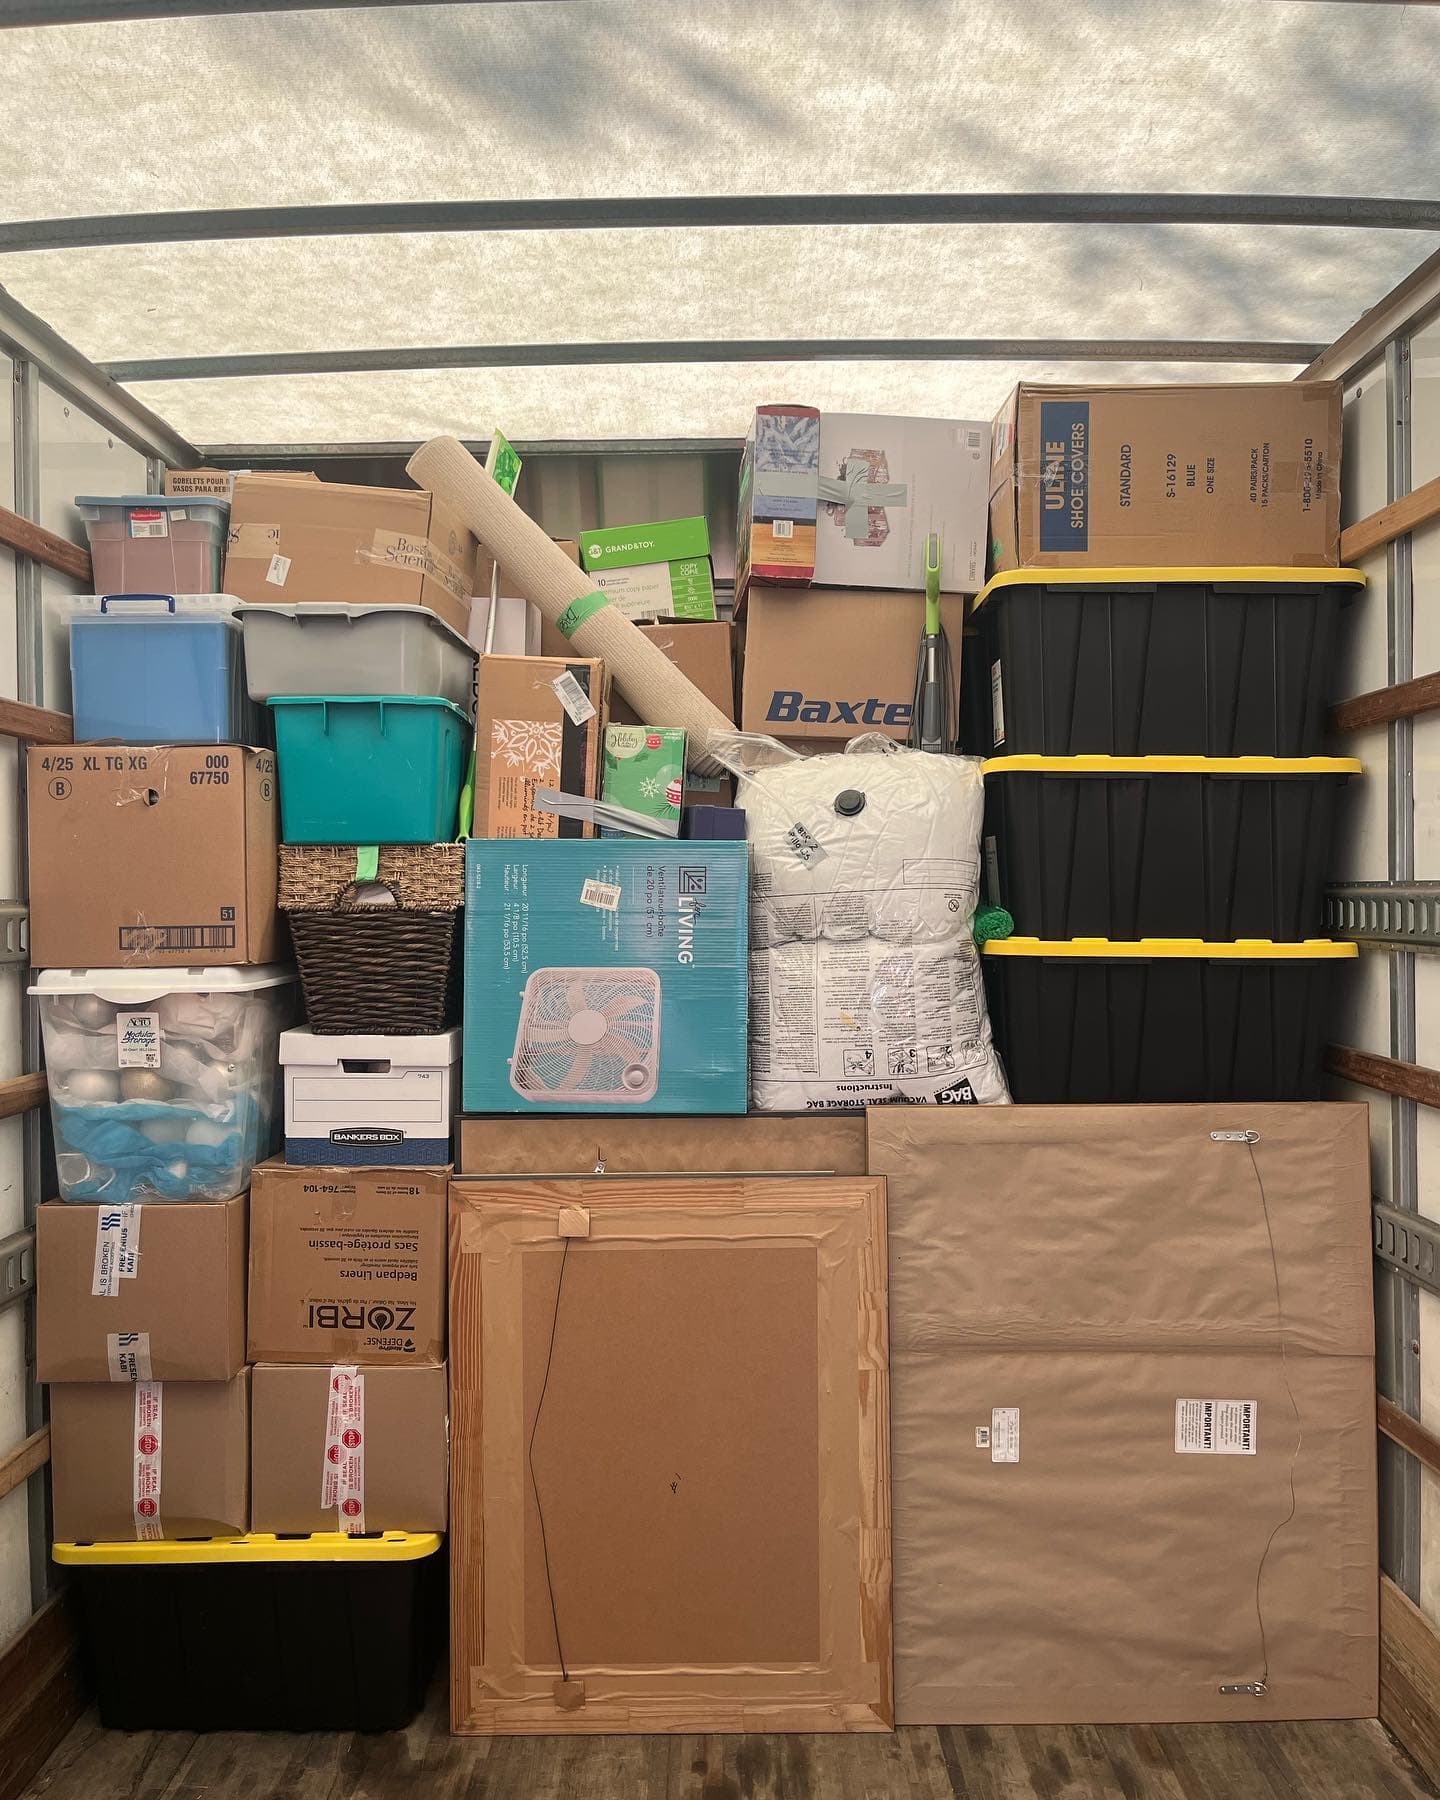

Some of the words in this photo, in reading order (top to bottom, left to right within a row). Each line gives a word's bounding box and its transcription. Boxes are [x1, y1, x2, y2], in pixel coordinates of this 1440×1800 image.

[1071, 422, 1085, 484] COVERS
[1207, 457, 1215, 474] SIZE
[172, 477, 204, 485] GOBELETS
[1120, 444, 1132, 507] STANDARD
[1166, 453, 1177, 498] S-16129
[1186, 464, 1196, 487] BLUE
[1070, 490, 1084, 529] SHOE
[606, 541, 654, 554] GRAND&TOY
[598, 578, 606, 586] 10
[765, 690, 914, 726] Baxte
[42, 757, 73, 771] 4/25
[82, 757, 100, 770] XL
[105, 756, 123, 770] TG
[128, 756, 148, 770] XG
[206, 755, 229, 769] 000
[190, 771, 230, 785] 67750
[56, 782, 64, 796] B
[512, 864, 520, 890] Largeur
[646, 866, 655, 877] de
[646, 880, 655, 890] 20
[644, 892, 652, 904] po
[658, 866, 666, 937] Ventilateur-boîte
[504, 902, 510, 910] 21
[522, 902, 529, 912] 20
[222, 910, 233, 919] 51
[502, 928, 509, 938] po
[511, 922, 518, 931] po
[645, 922, 654, 938] cm)
[678, 896, 694, 964] LIVING
[520, 932, 527, 942] po
[512, 950, 520, 962] cm)
[521, 961, 530, 974] cm)
[865, 1050, 872, 1058] 4
[909, 1049, 915, 1058] 3
[836, 1084, 892, 1093] Instructions
[942, 1086, 972, 1103] BAG
[826, 1100, 864, 1108] STORAGE
[304, 1185, 340, 1194] 764-104
[118, 1228, 128, 1272] FREENIUS
[309, 1239, 390, 1251] protège-bassin
[394, 1242, 418, 1252] Sacs
[101, 1242, 110, 1276] BROKEN
[340, 1270, 372, 1280] Liners
[376, 1270, 418, 1281] Bedpan
[100, 1278, 108, 1286] IS
[309, 1306, 416, 1332] ZORBI
[366, 1338, 402, 1346] DEFENSE
[120, 1353, 128, 1372] KABI
[128, 1352, 138, 1382] FRESEN
[1204, 1402, 1212, 1449] IMPORTANT!
[1242, 1404, 1251, 1450] IMPORTANT!
